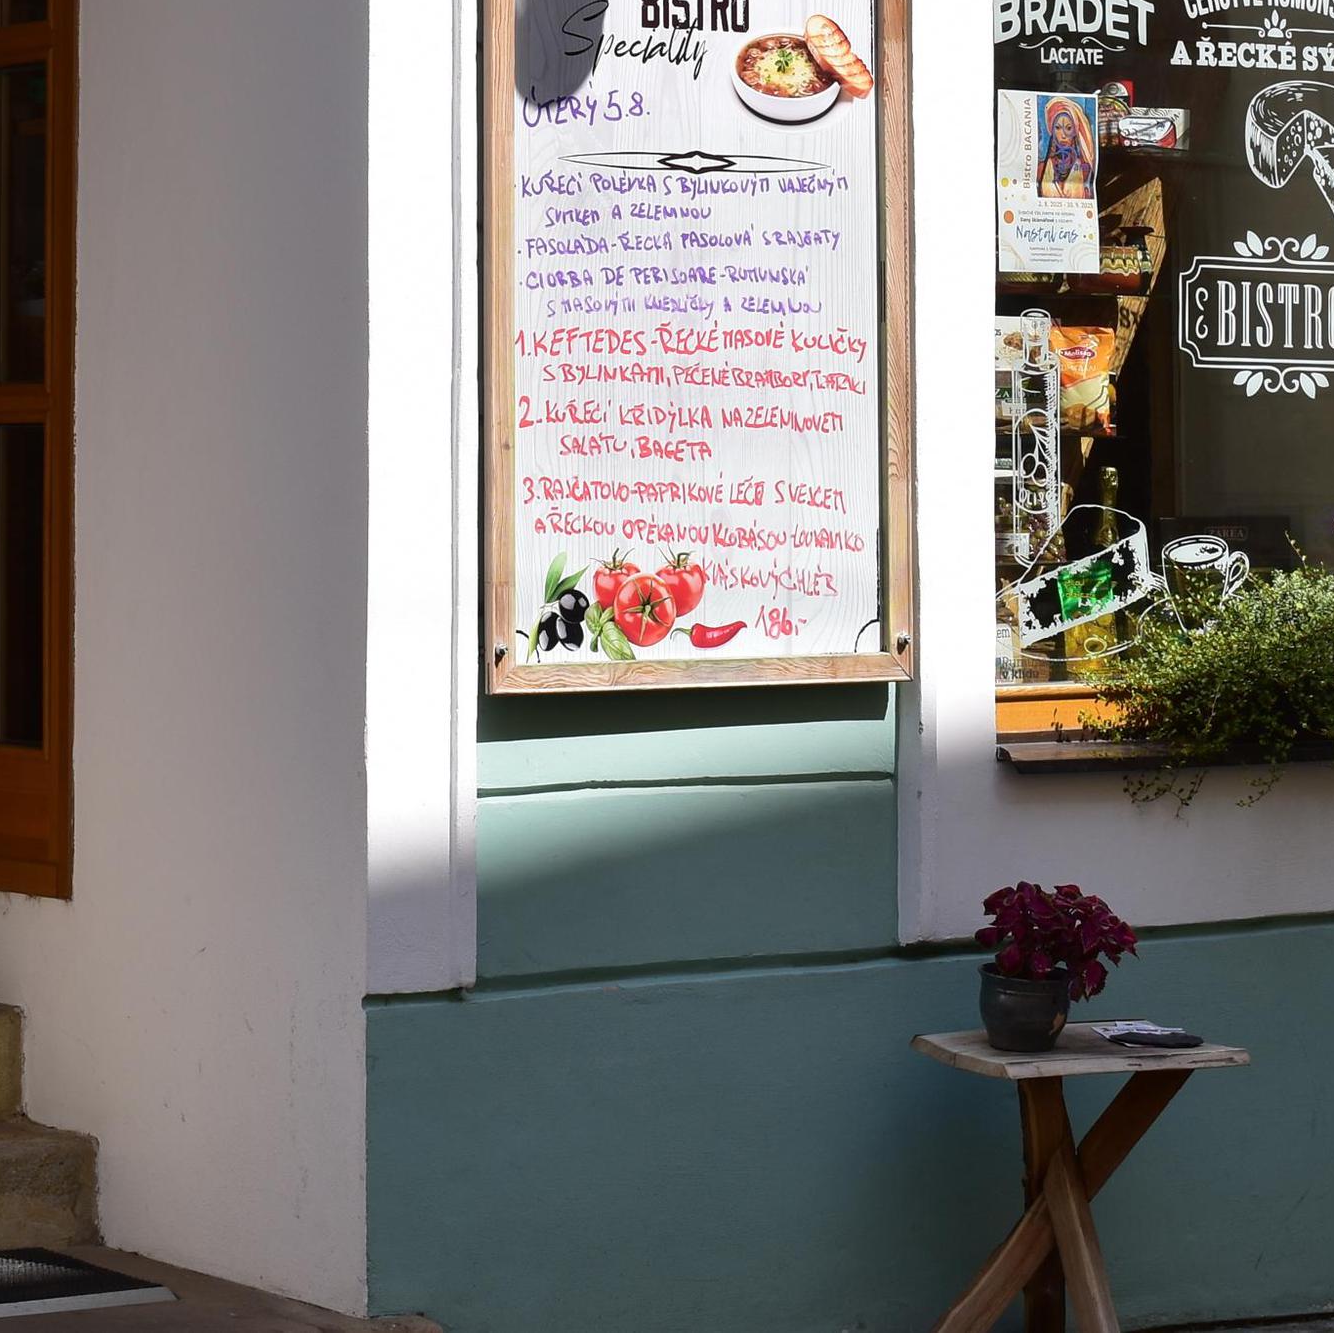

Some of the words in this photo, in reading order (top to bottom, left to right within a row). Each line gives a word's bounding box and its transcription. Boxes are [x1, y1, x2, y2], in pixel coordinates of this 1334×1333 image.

[562, 0, 708, 79] Speciality
[1041, 47, 1103, 65] LACTATE
[1170, 42, 1186, 64] A
[1195, 37, 1297, 69] ŘECKÉ
[522, 81, 596, 127] ÚTERÝ
[1023, 155, 1031, 188] Bistro
